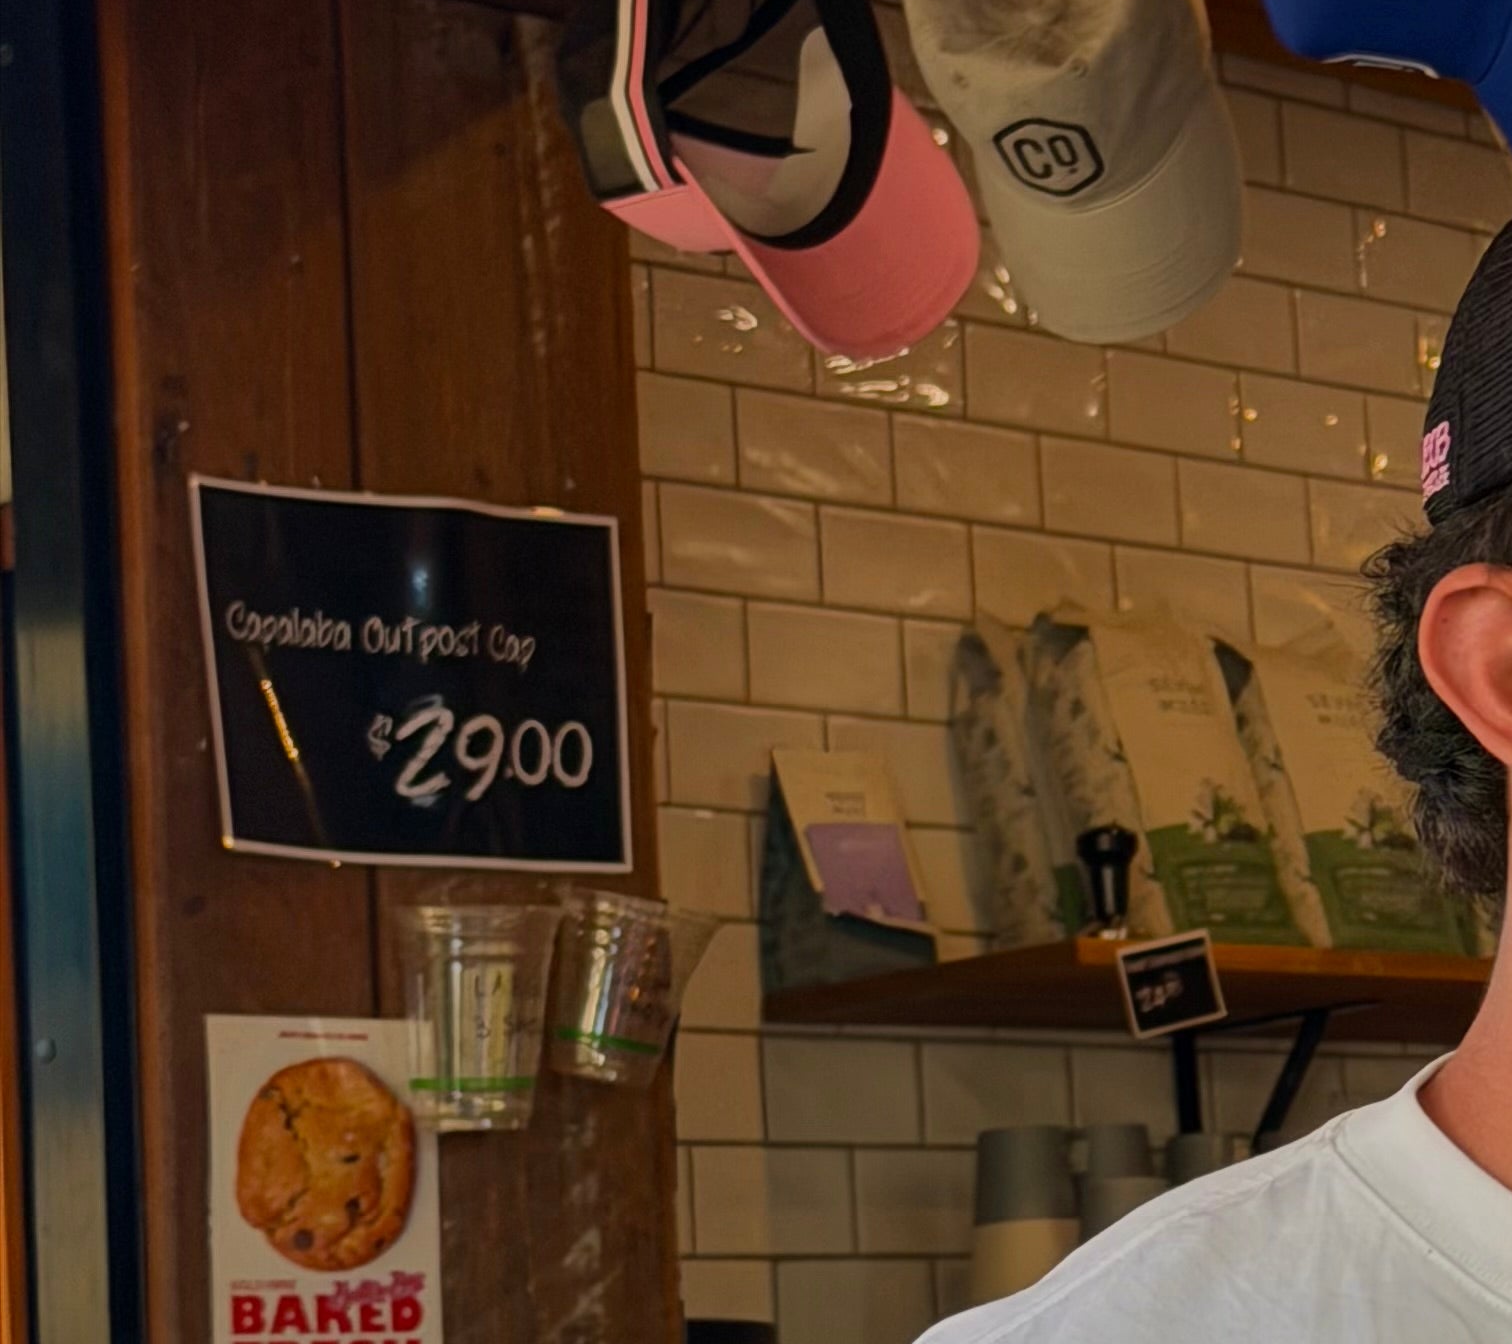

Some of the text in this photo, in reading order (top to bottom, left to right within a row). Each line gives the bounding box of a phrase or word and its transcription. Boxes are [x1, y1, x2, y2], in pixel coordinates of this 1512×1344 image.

[489, 624, 536, 673] Cap
[367, 694, 593, 806] $29.00
[231, 1294, 424, 1334] BAKED
